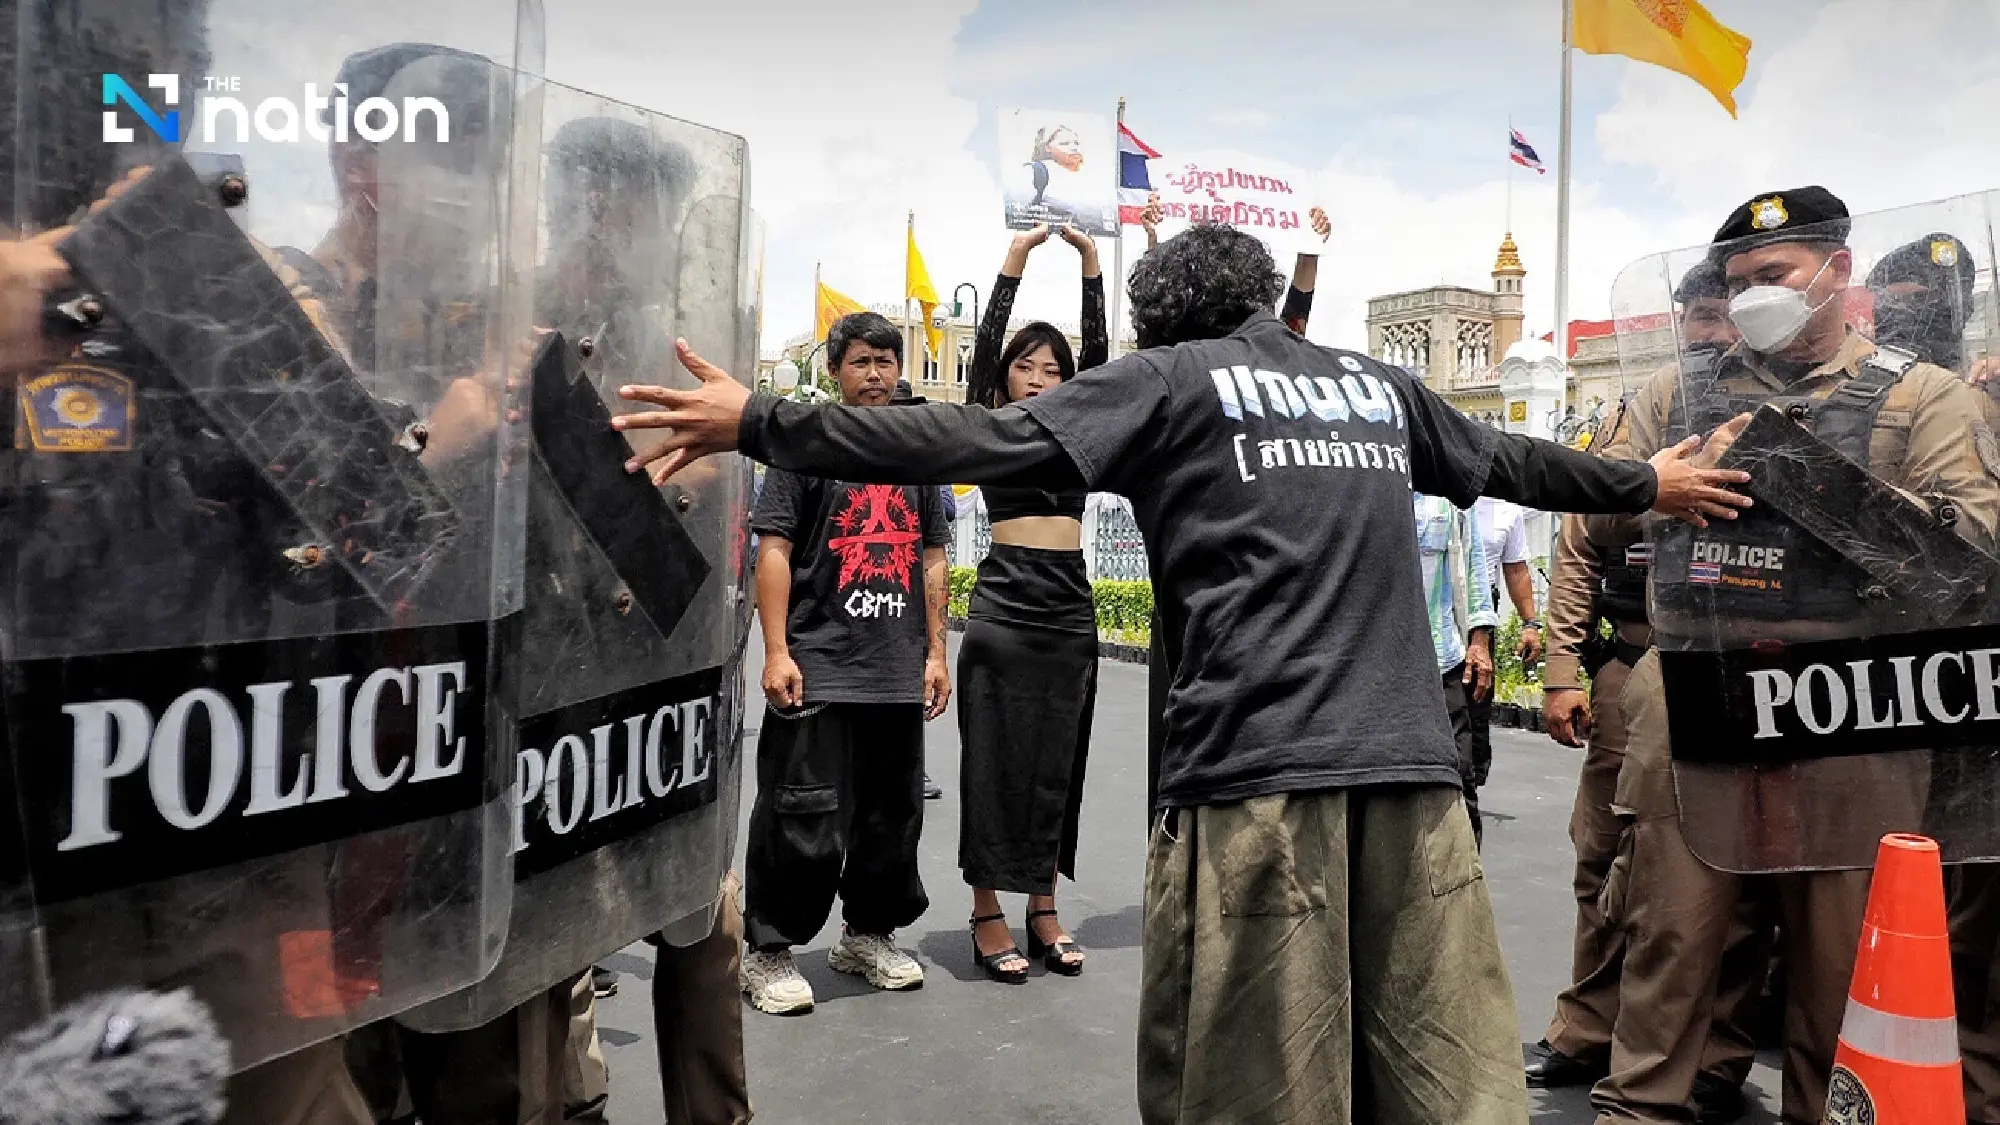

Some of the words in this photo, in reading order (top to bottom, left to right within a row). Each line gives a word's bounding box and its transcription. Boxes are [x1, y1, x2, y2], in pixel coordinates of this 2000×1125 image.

[1161, 198, 1299, 229] การยติธรรม
[1691, 541, 1786, 570] POLICE
[1745, 648, 2000, 739] POLICE
[57, 661, 467, 851] POLICE
[506, 696, 712, 857] POLICE
